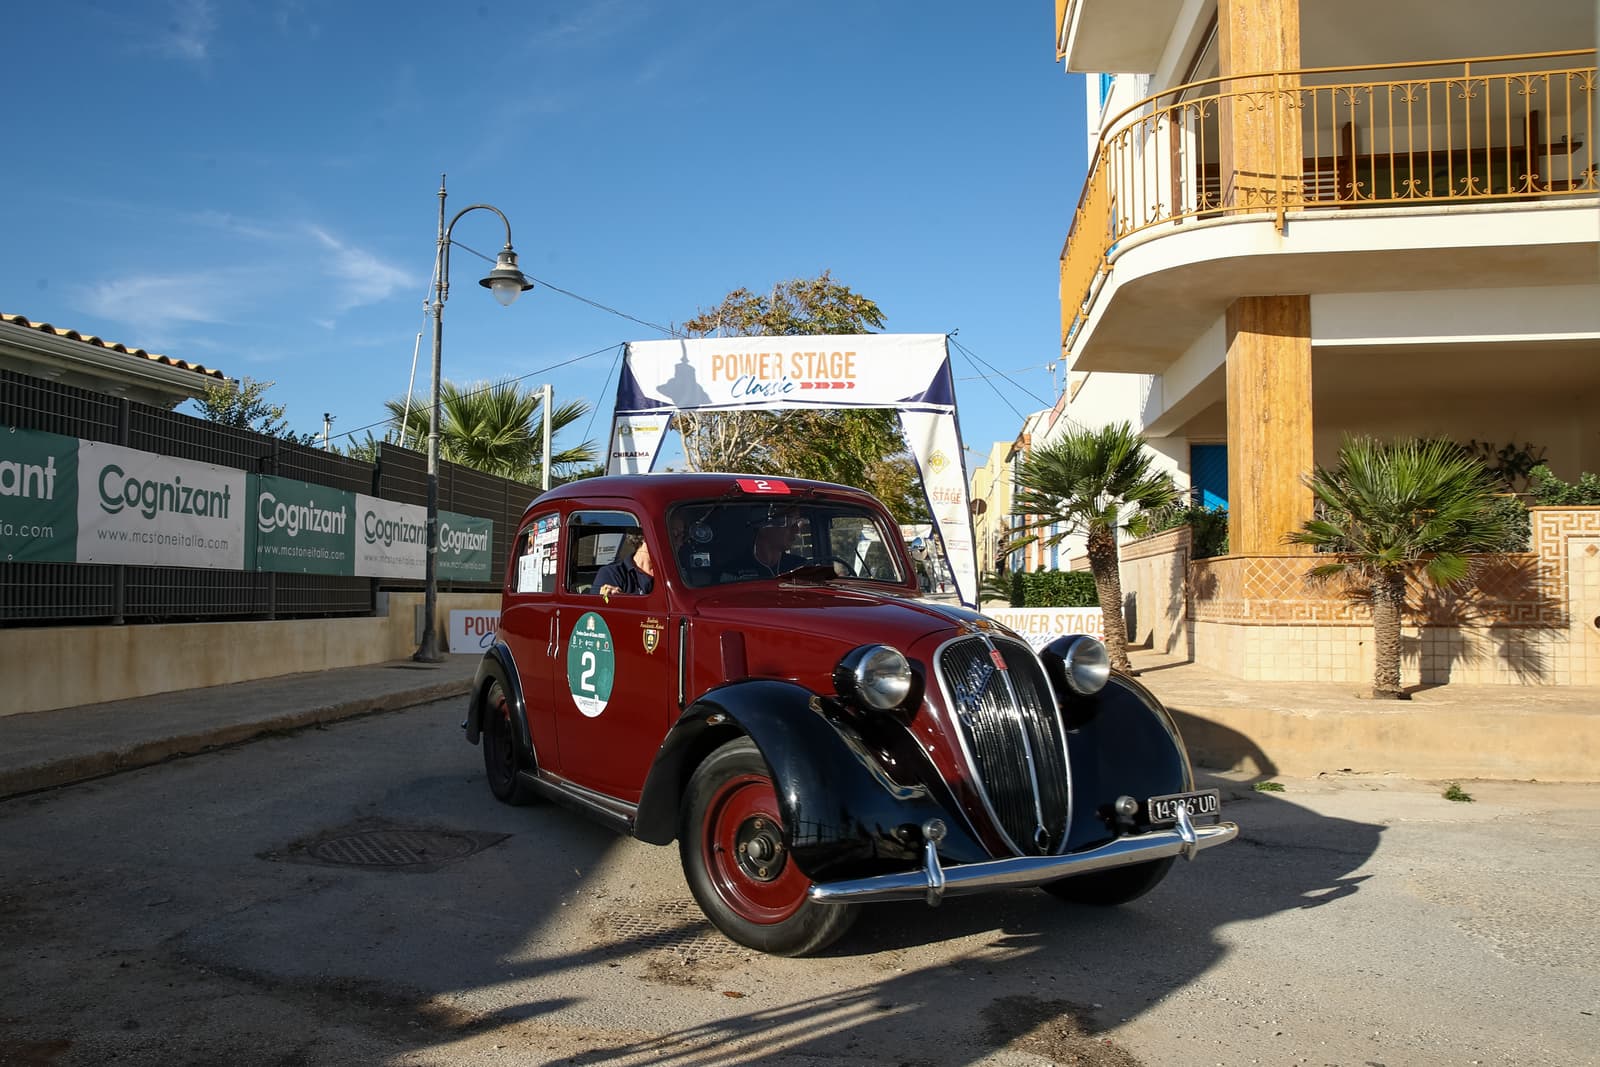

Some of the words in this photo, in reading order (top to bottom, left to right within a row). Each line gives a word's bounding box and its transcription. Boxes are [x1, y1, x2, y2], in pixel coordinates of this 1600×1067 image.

[712, 353, 784, 381] POWER
[791, 351, 856, 379] STAGE
[731, 375, 795, 398] Classic
[98, 464, 231, 520] Cognizant
[754, 479, 772, 490] 2
[258, 491, 347, 537] Cognizant
[364, 511, 427, 547] Cognizant
[97, 529, 229, 550] www.mcstoneitalia.com
[440, 523, 488, 555] Cognizant
[581, 651, 596, 692] 2
[1199, 795, 1217, 813] UD
